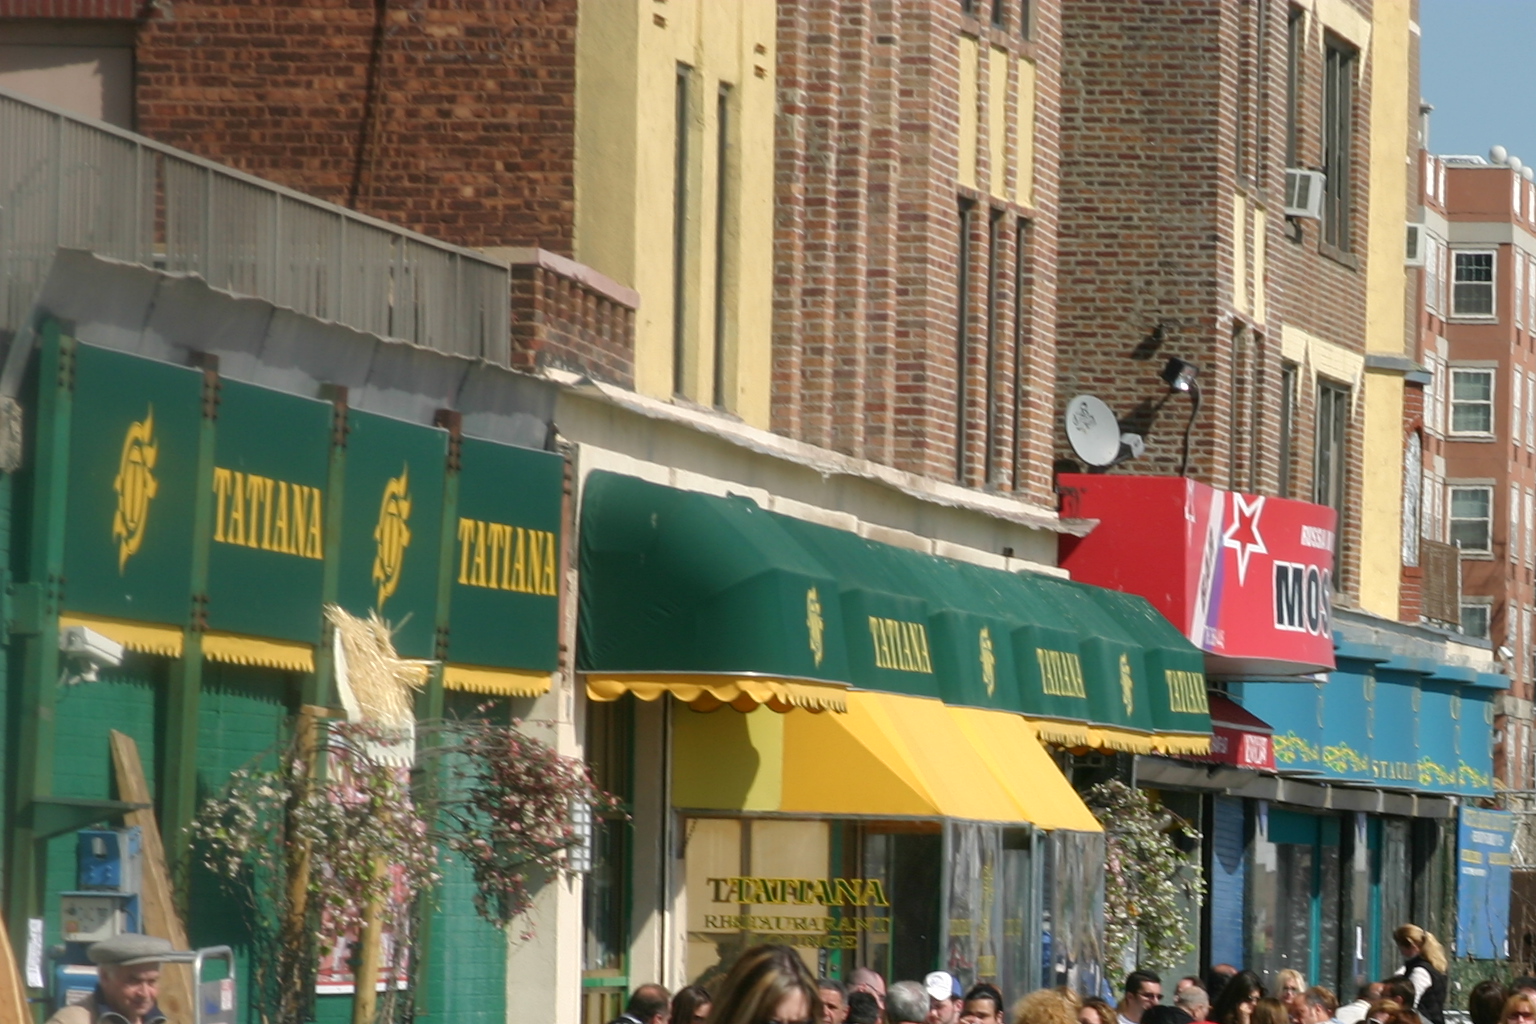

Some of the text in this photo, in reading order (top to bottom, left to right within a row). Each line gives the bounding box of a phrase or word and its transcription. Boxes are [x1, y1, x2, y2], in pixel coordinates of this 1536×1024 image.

[212, 466, 324, 560] TATIANA
[457, 516, 557, 596] TATIANA
[868, 615, 933, 674] TATIANA
[1036, 647, 1086, 699] TATIANA
[727, 876, 890, 908] TATIANA
